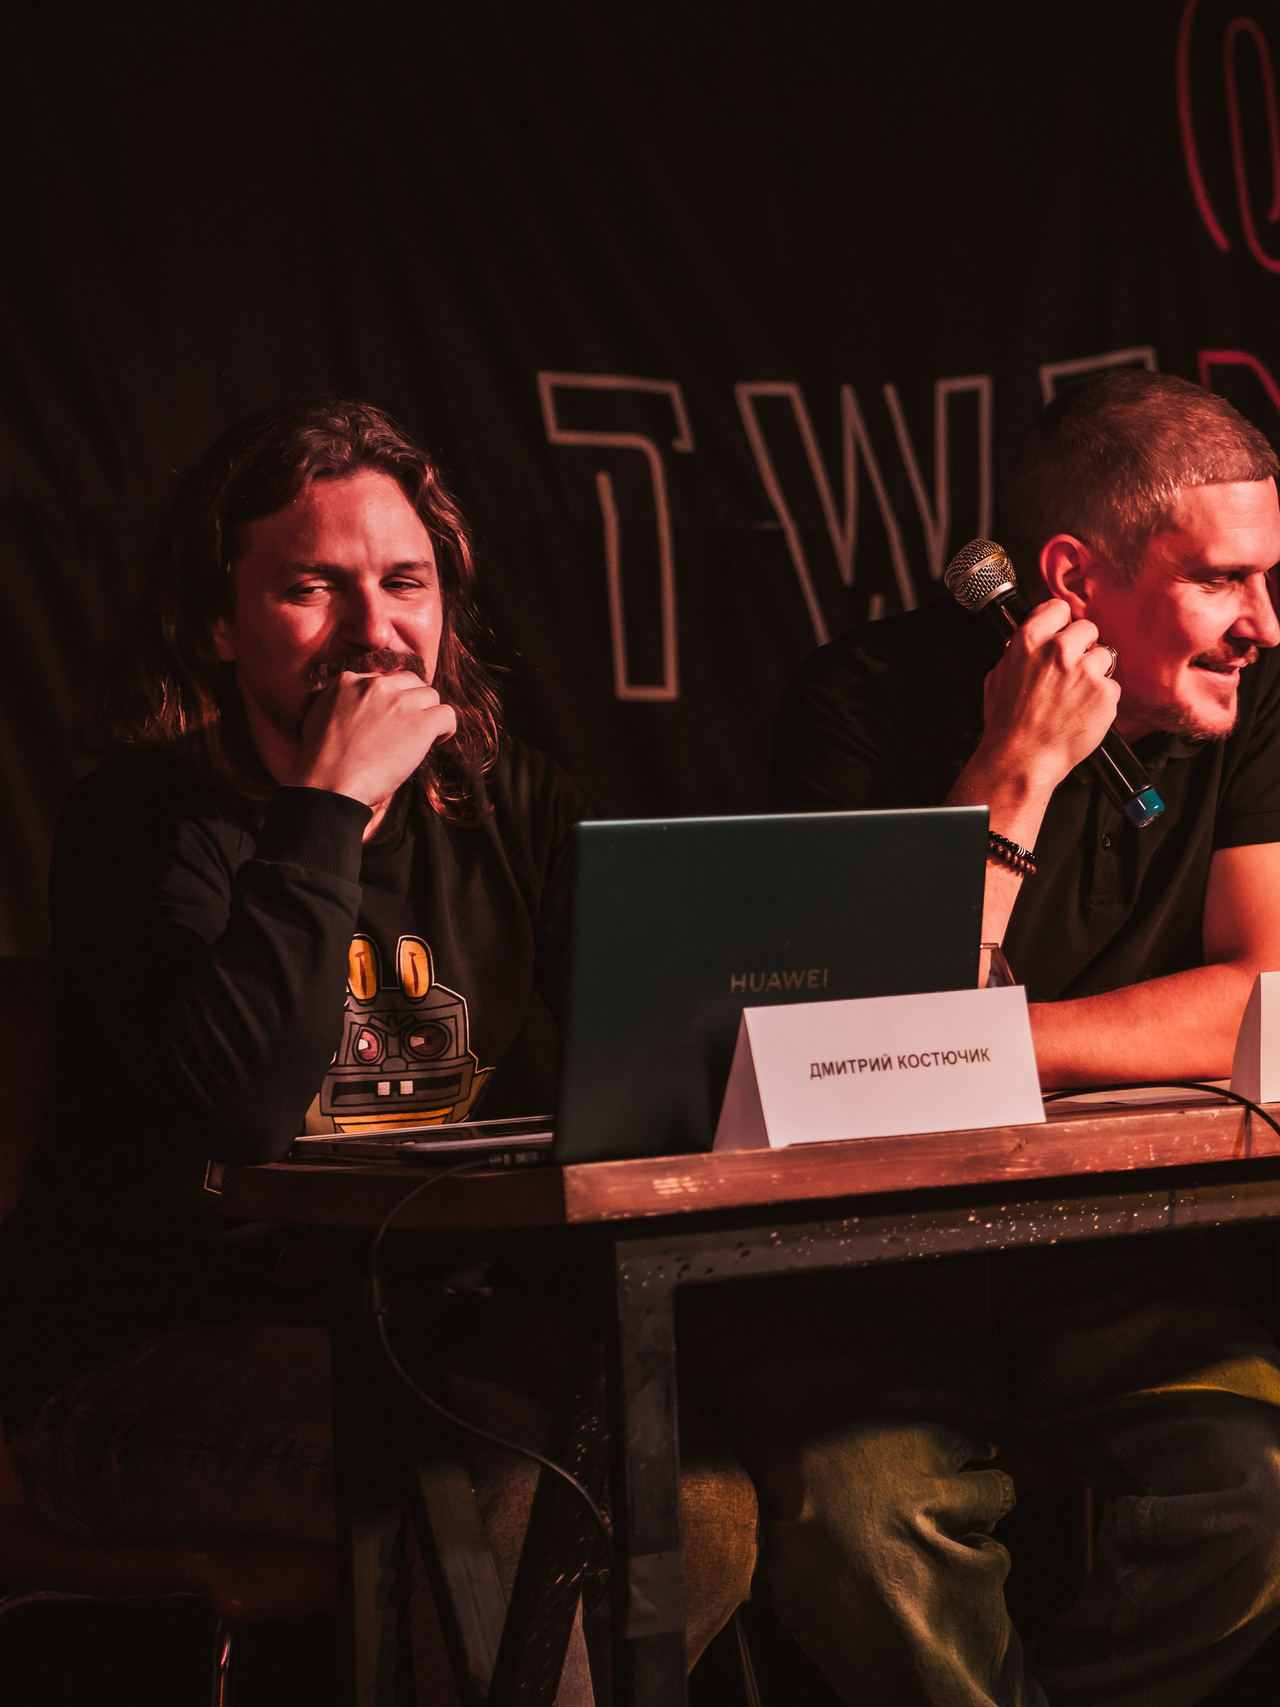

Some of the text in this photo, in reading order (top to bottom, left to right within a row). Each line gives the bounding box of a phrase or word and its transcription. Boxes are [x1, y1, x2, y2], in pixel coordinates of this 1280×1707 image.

[730, 968, 829, 994] HUAWEI
[809, 1047, 991, 1081] ДМИТРИЙ КОСТЮЧИК
